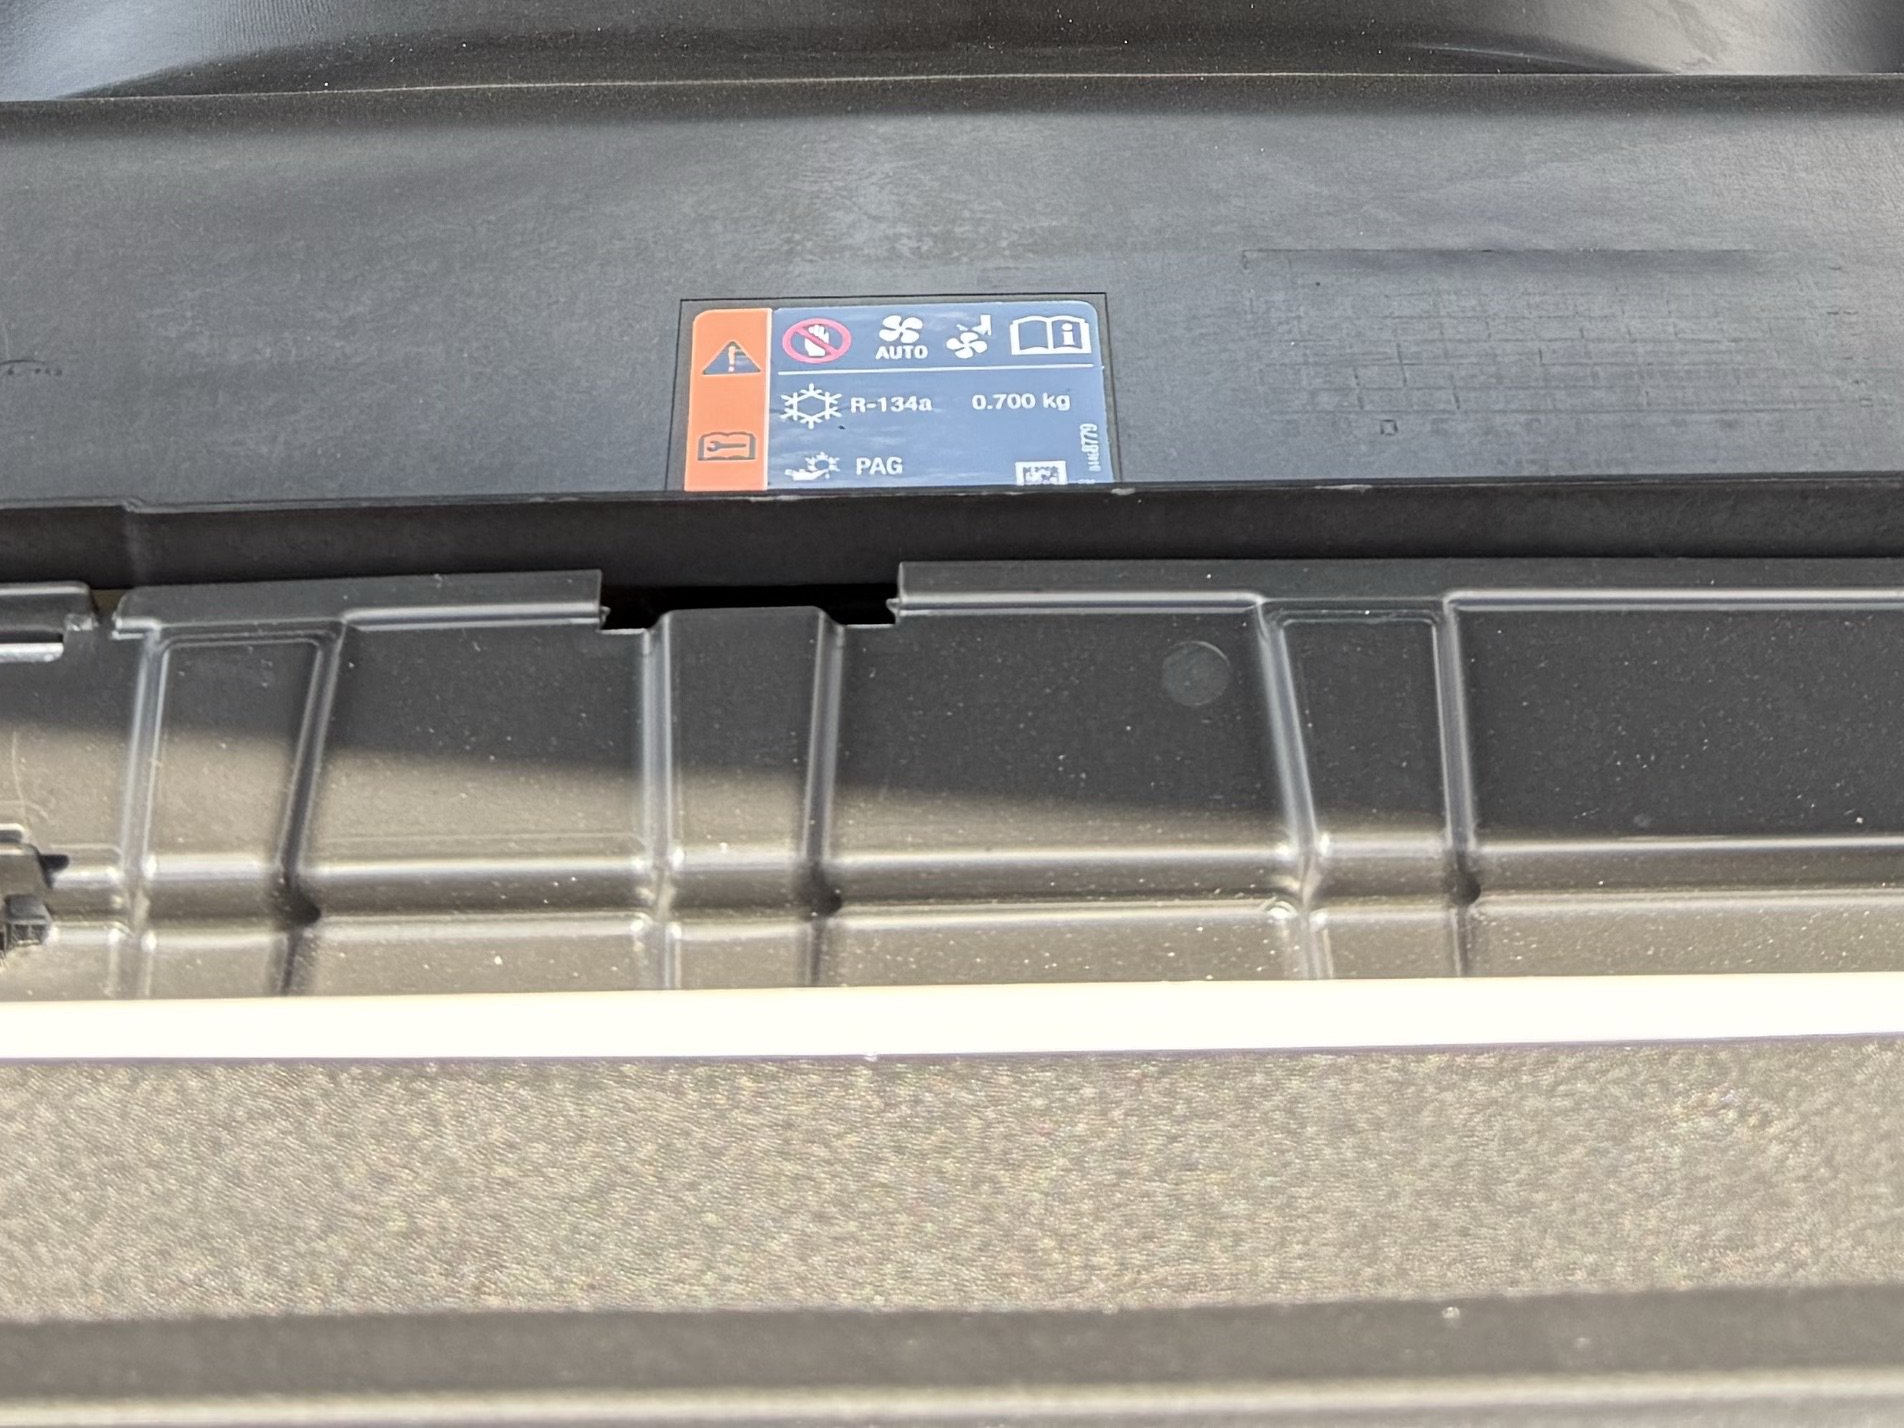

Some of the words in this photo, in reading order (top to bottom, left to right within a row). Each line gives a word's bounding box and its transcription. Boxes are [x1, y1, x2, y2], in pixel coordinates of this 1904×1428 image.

[875, 345, 928, 360] AUTO
[850, 395, 933, 414] R-134a
[971, 393, 1036, 410] 0.700
[1042, 392, 1071, 411] kg
[856, 456, 903, 476] PAG
